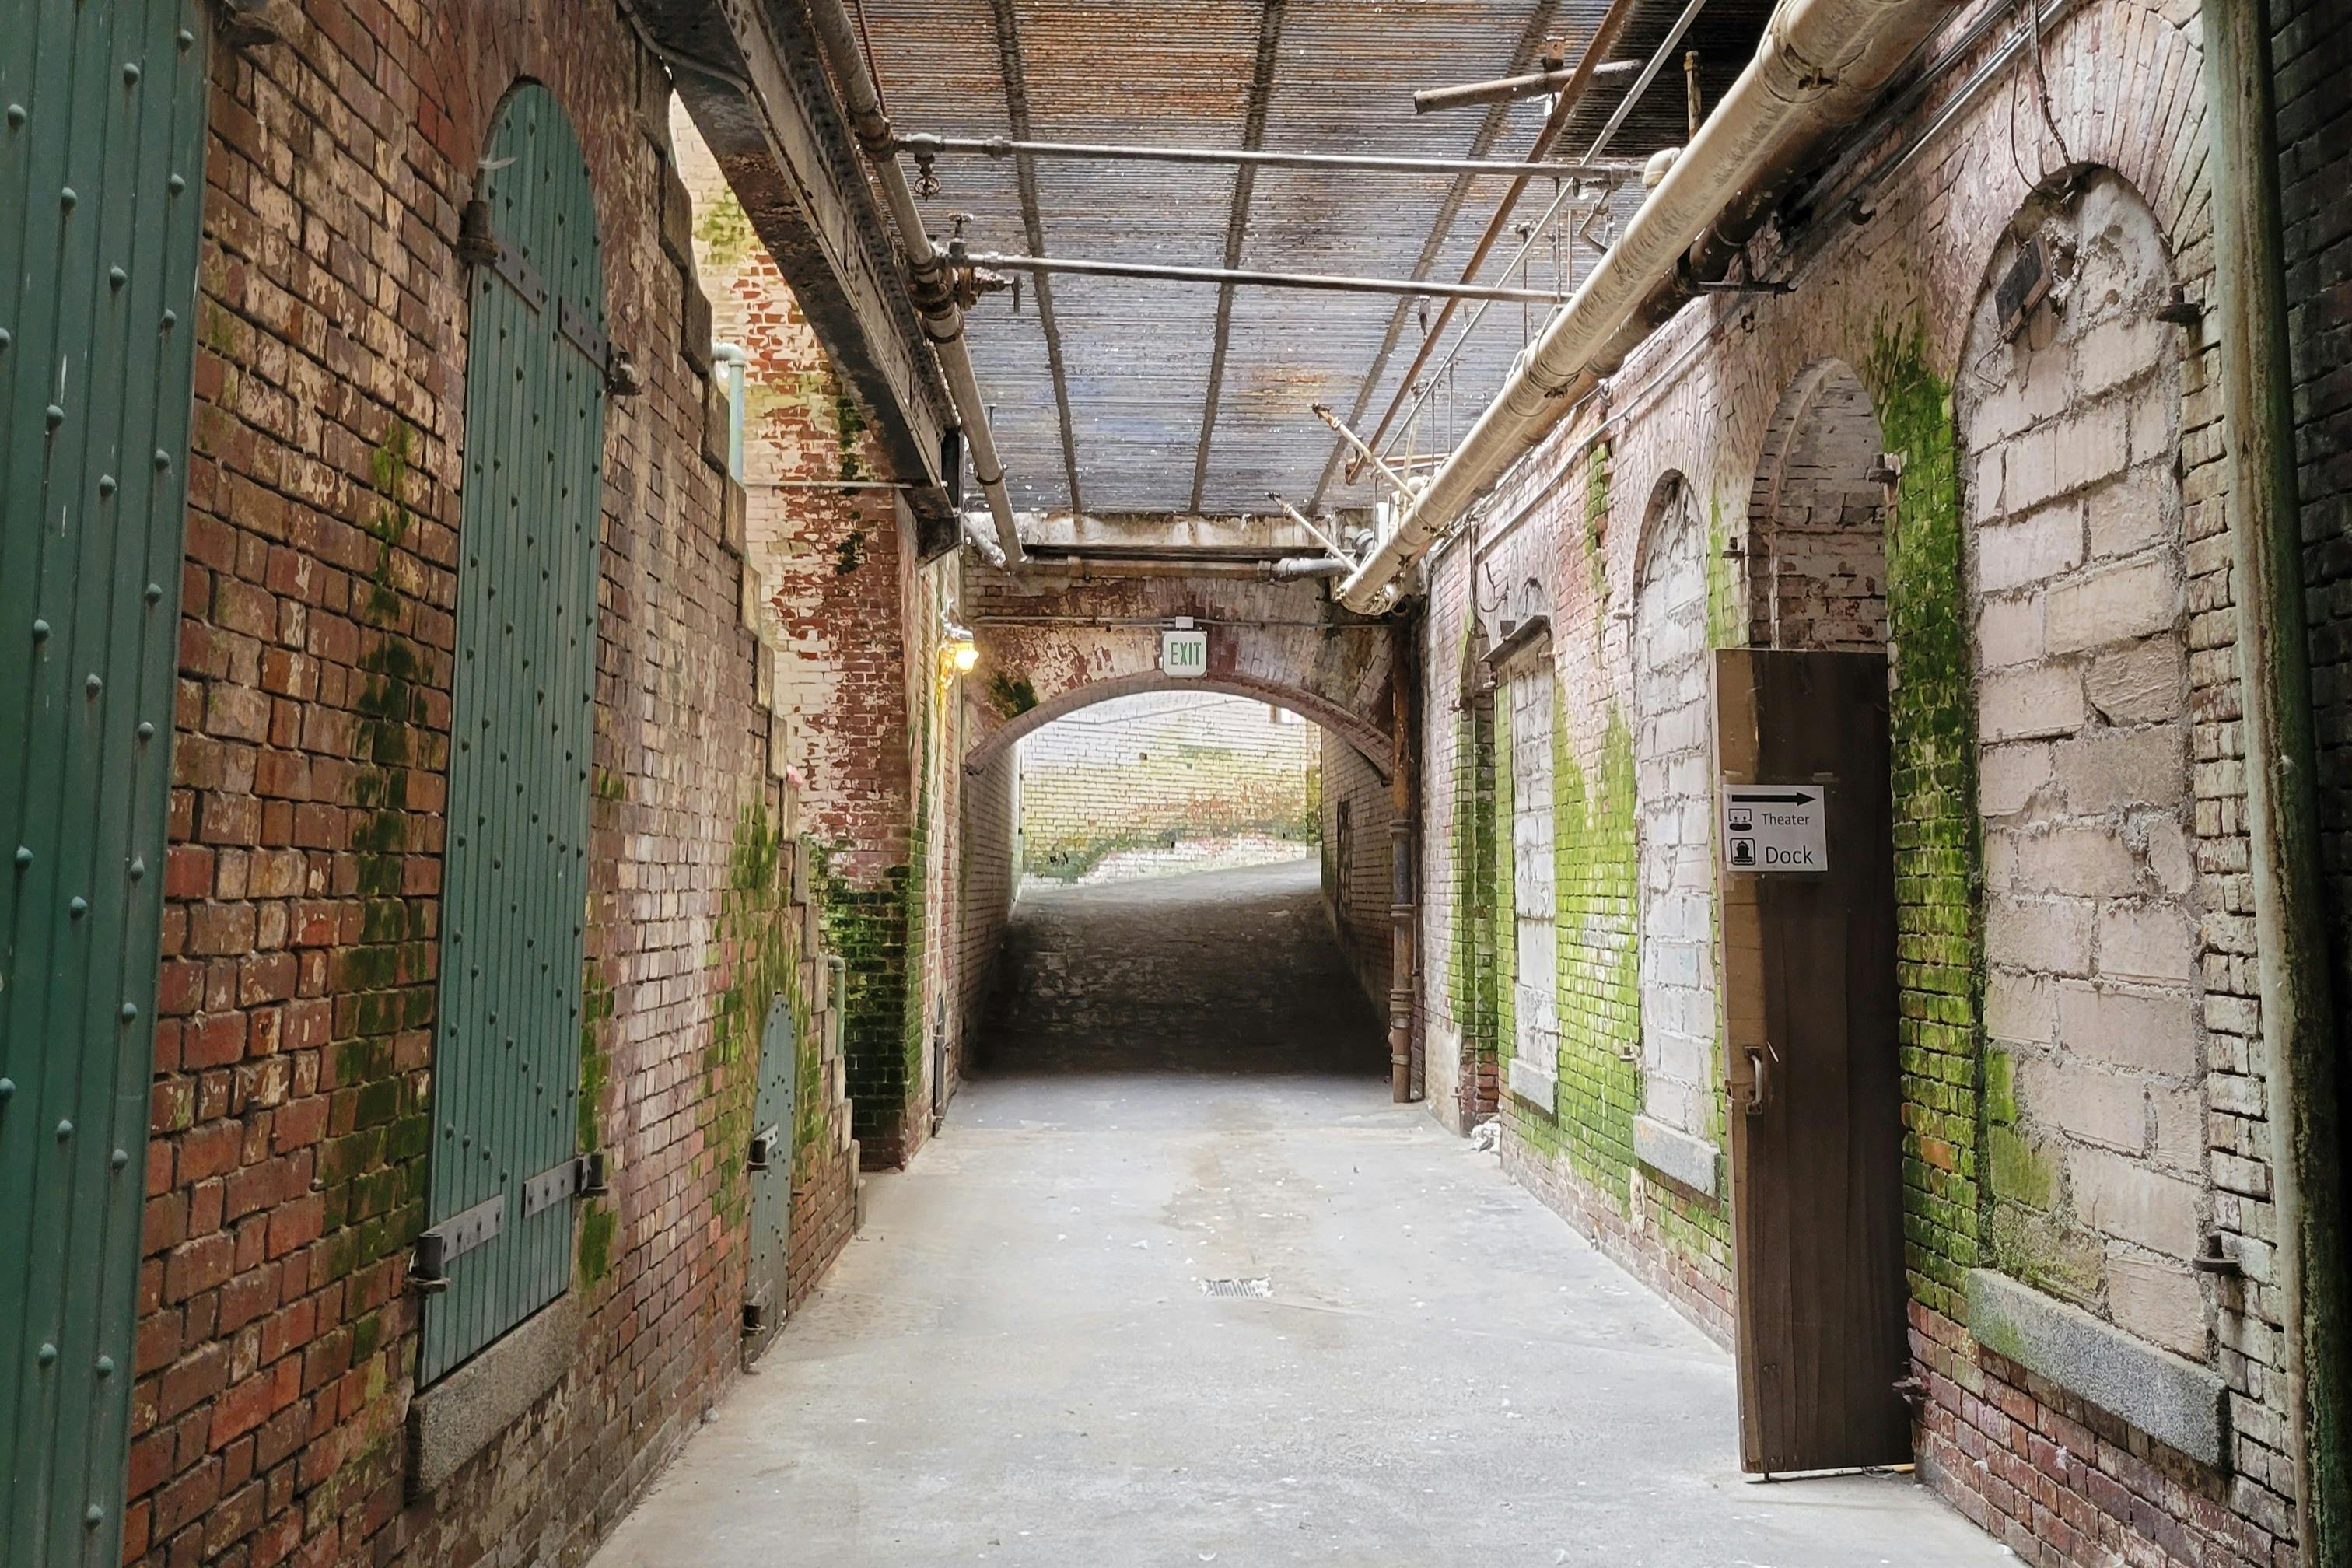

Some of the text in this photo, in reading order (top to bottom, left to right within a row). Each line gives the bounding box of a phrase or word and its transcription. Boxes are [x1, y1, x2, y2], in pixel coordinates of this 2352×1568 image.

[1170, 642, 1202, 666] EXIT
[1761, 813, 1810, 825] Theater
[1766, 845, 1814, 865] Dock
